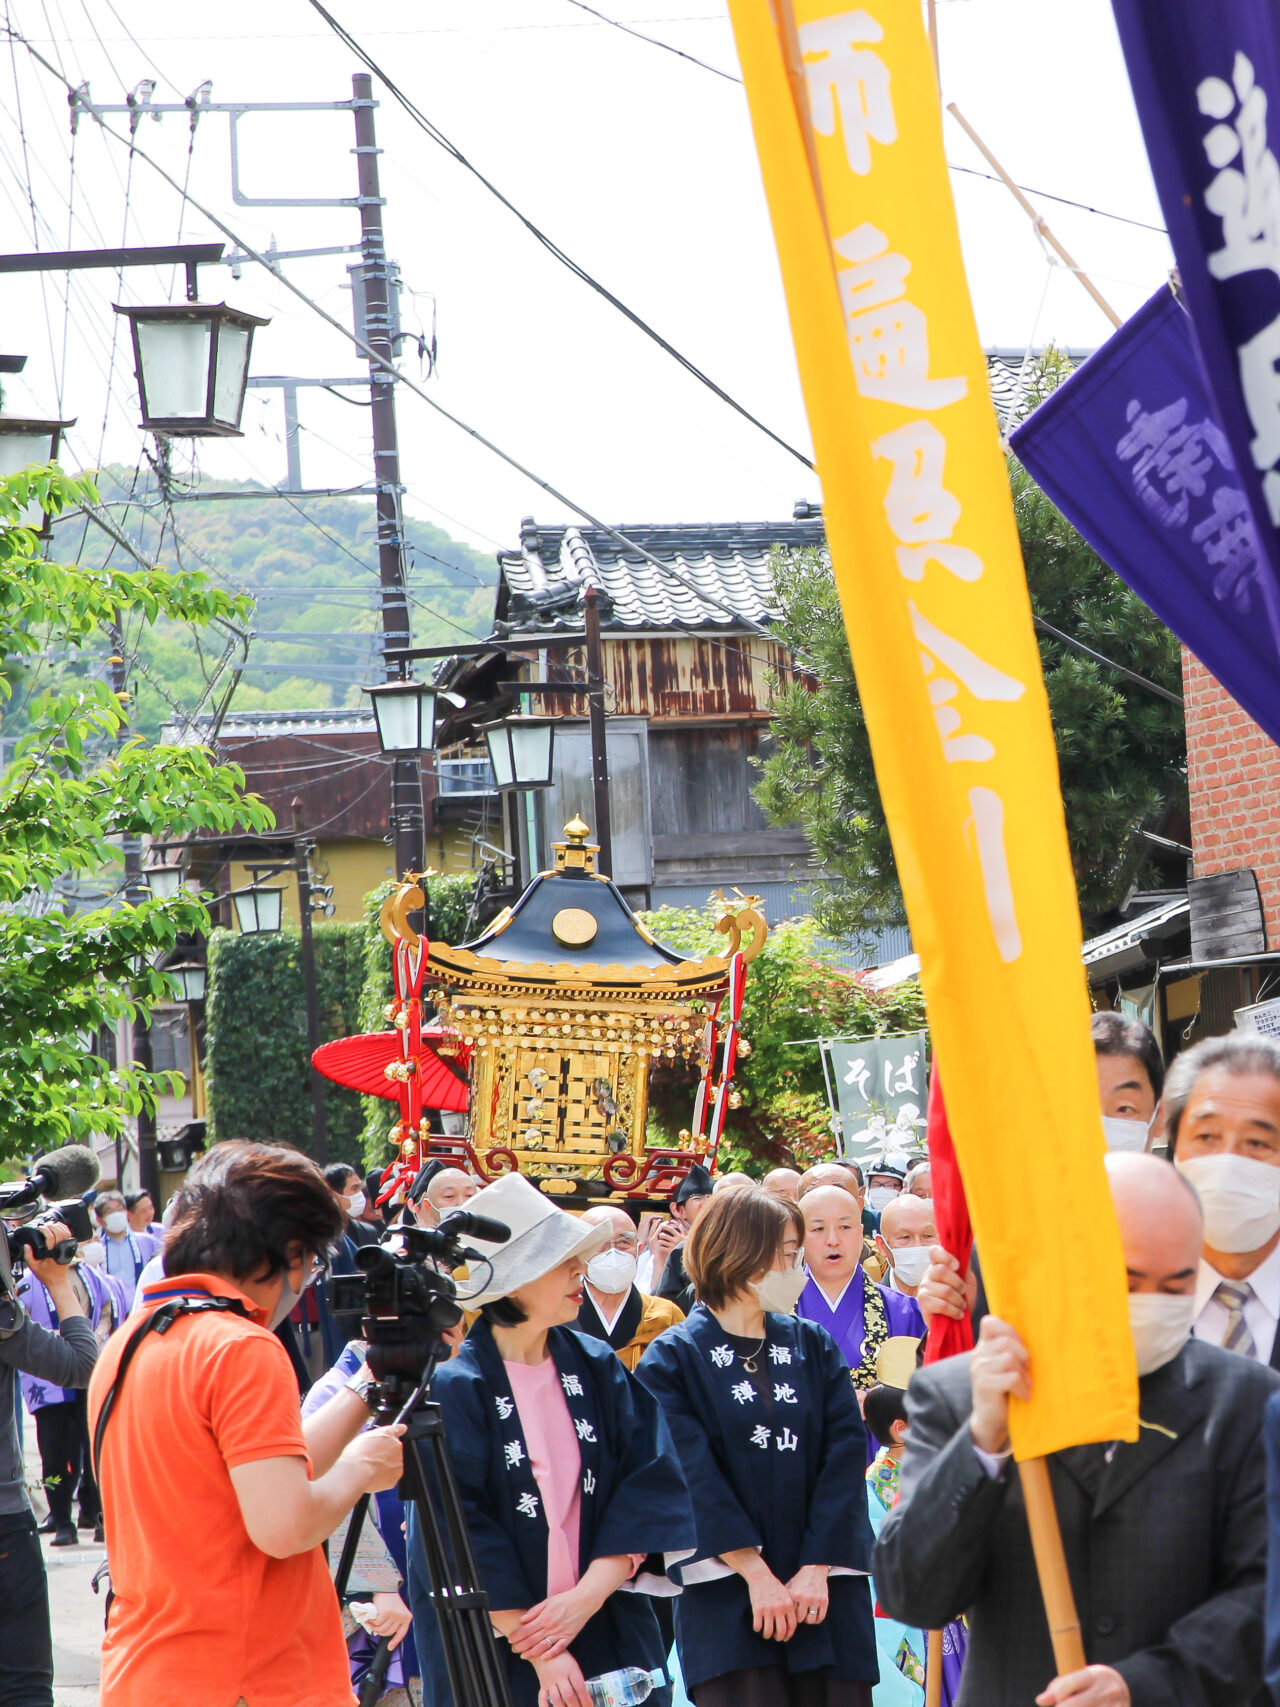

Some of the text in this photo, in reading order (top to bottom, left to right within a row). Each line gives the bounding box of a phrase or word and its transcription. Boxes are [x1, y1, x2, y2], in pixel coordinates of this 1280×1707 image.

[843, 1051, 921, 1101] そば
[561, 1372, 598, 1495] 福地山
[767, 1343, 799, 1452] 福地山
